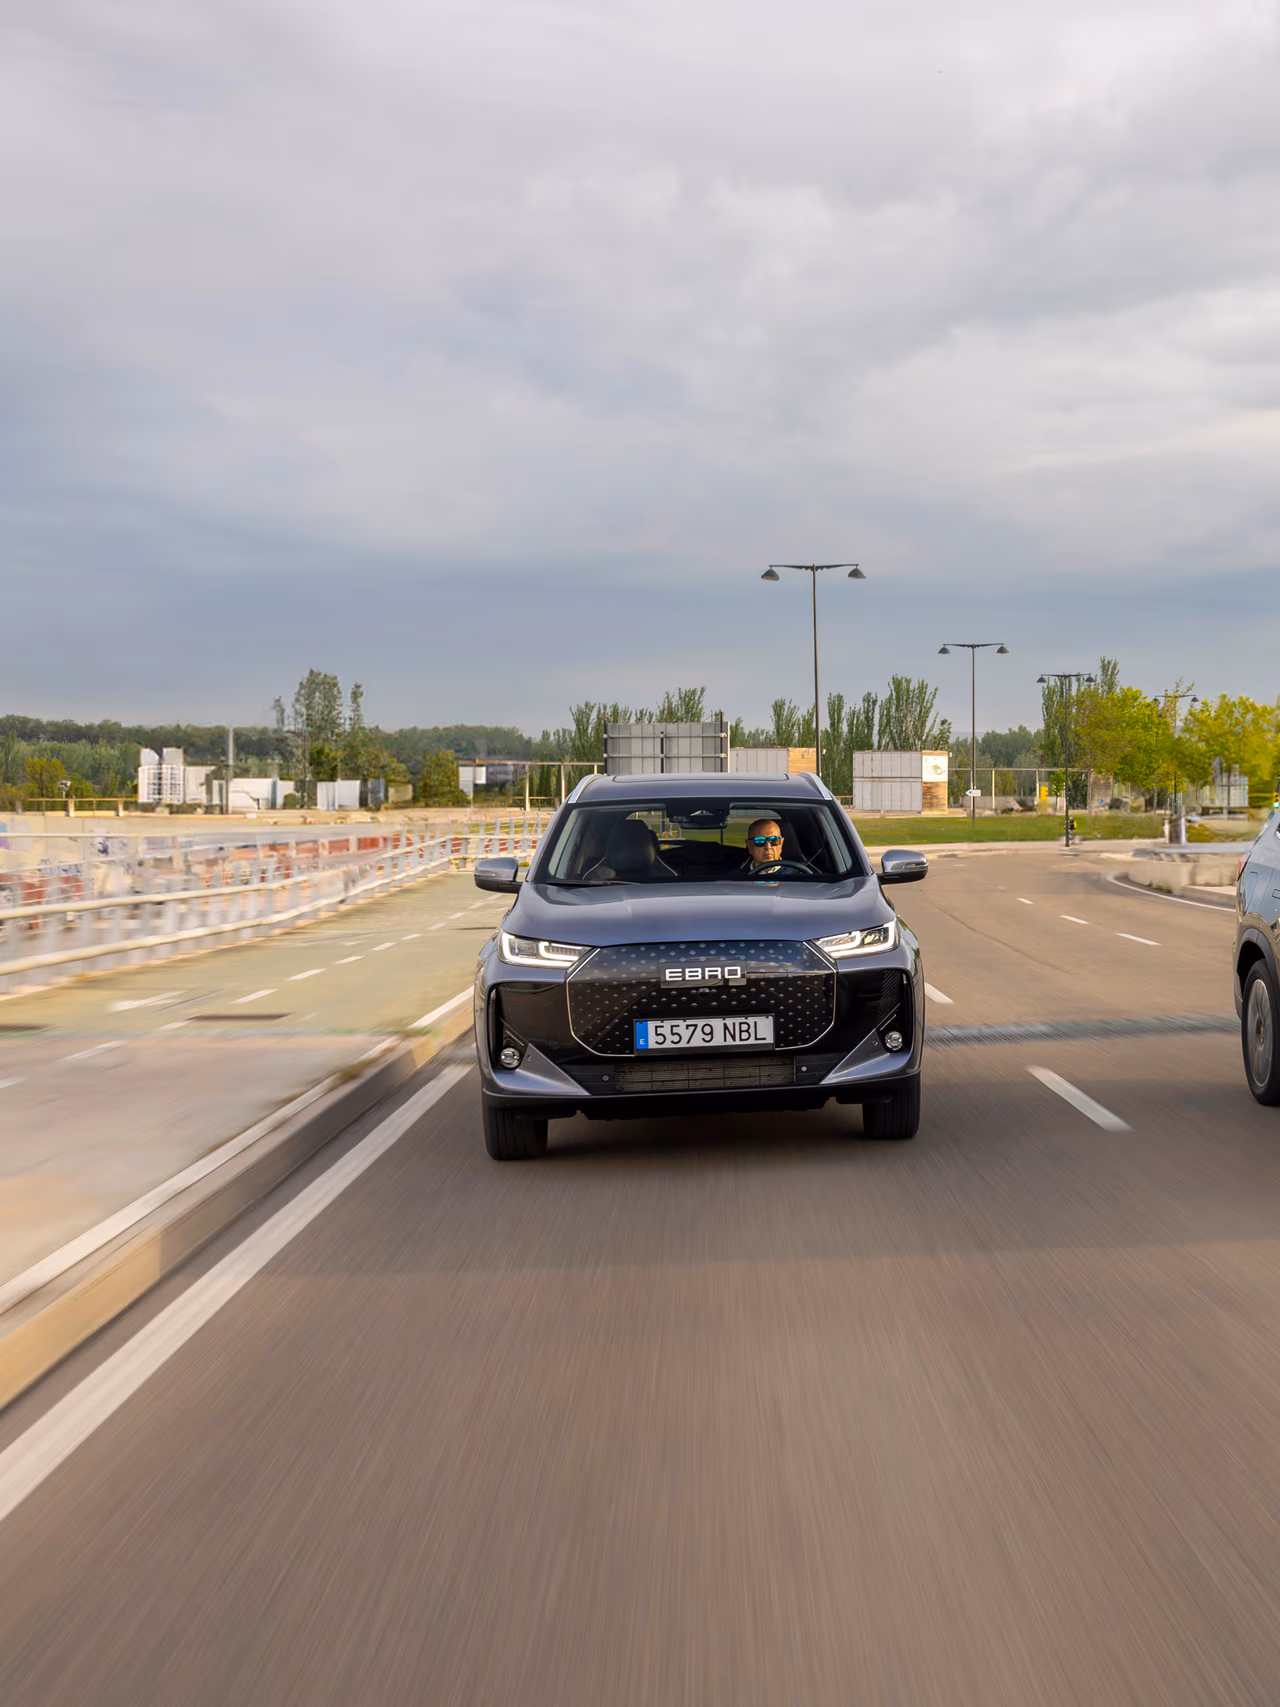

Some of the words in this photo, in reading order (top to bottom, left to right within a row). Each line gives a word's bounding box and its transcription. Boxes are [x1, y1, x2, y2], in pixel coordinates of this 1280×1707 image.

[665, 966, 741, 981] EBRO
[654, 1023, 715, 1046] 5579
[722, 1020, 767, 1043] NBL
